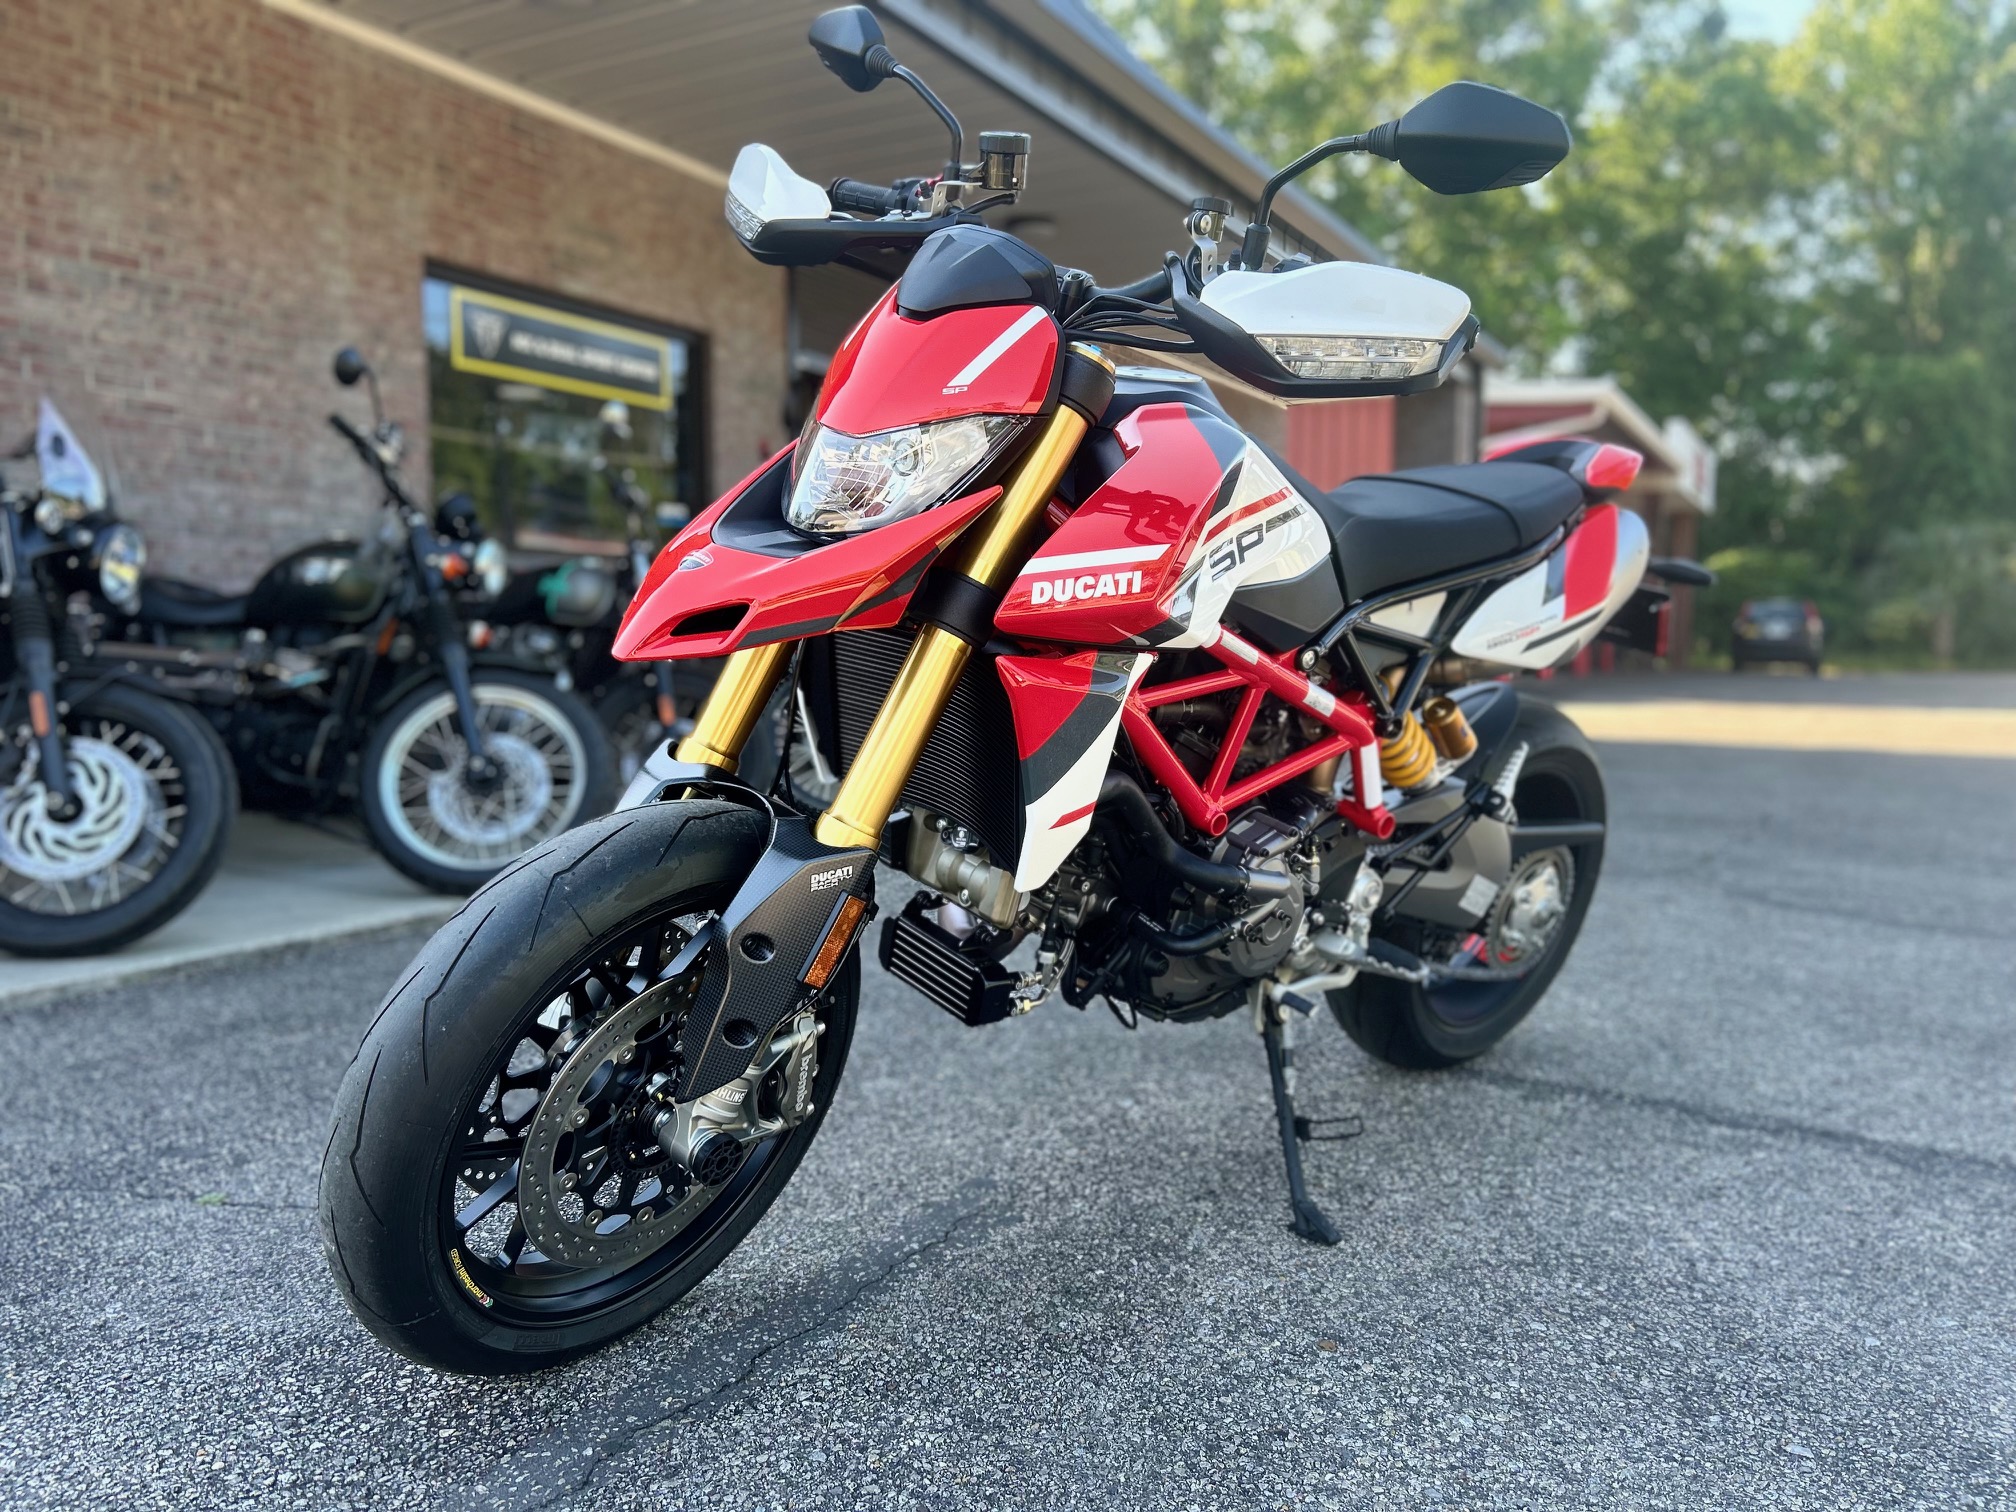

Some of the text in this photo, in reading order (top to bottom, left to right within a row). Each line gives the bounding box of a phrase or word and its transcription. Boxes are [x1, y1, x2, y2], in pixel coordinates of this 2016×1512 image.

[942, 386, 968, 395] SP
[1209, 523, 1265, 583] SP
[1031, 570, 1142, 605] DUCATI
[811, 866, 853, 883] DUCATI
[796, 1054, 812, 1111] brembo
[457, 1267, 484, 1298] marchesini
